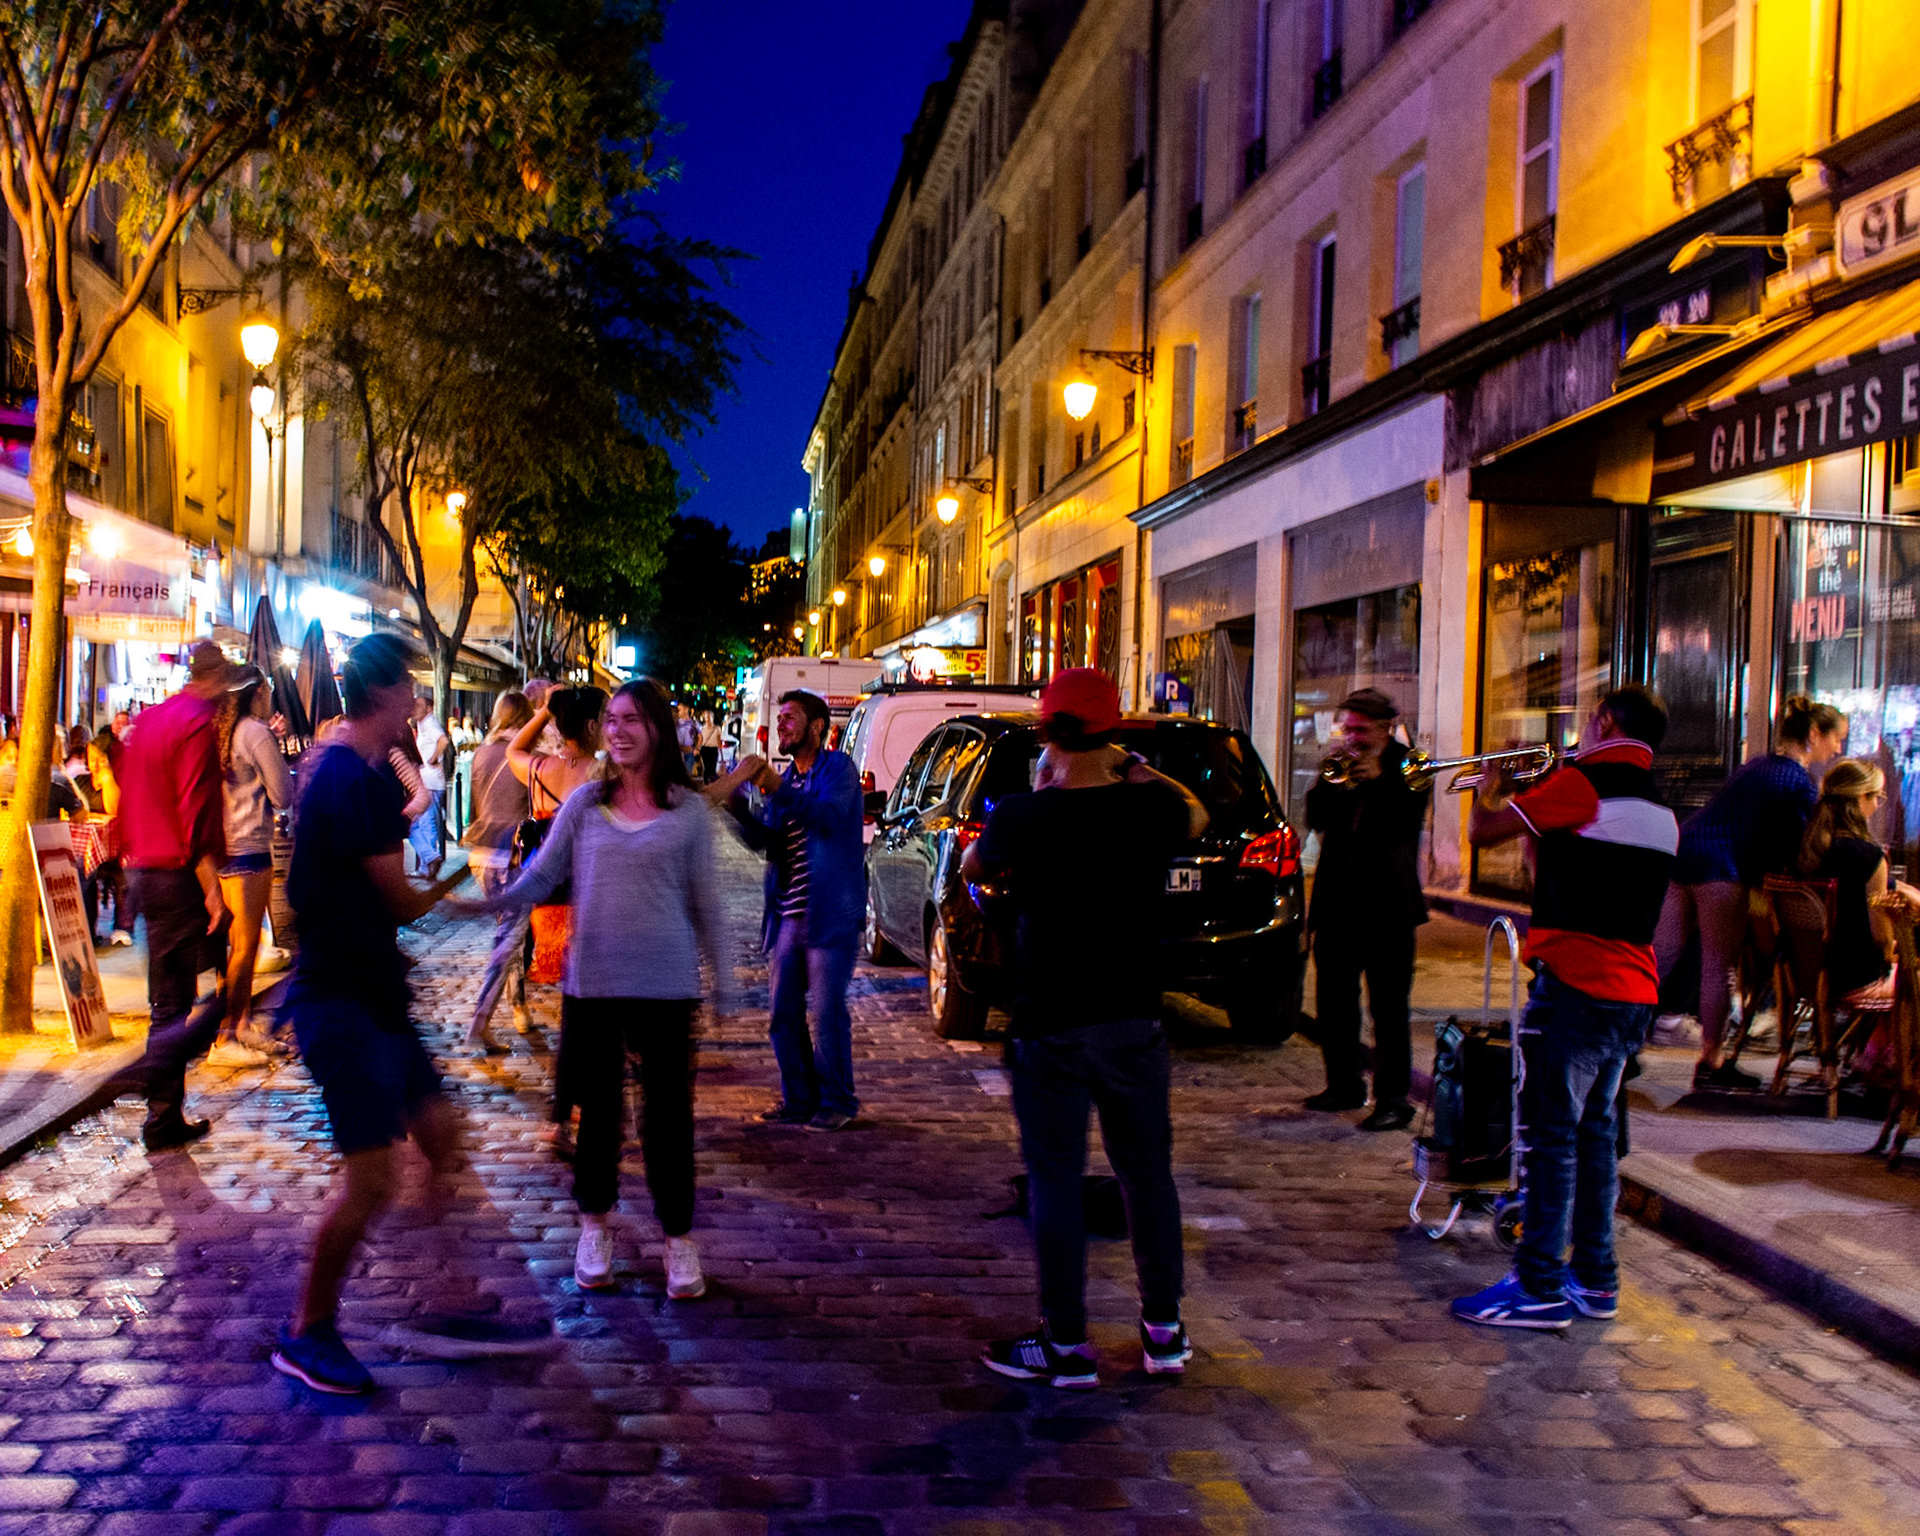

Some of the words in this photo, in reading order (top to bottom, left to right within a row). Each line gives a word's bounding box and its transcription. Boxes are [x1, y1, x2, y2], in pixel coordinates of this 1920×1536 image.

[1709, 375, 1882, 474] GALETTES
[88, 579, 171, 604] Français
[1818, 563, 1842, 593] thé
[1789, 593, 1846, 644] MENU
